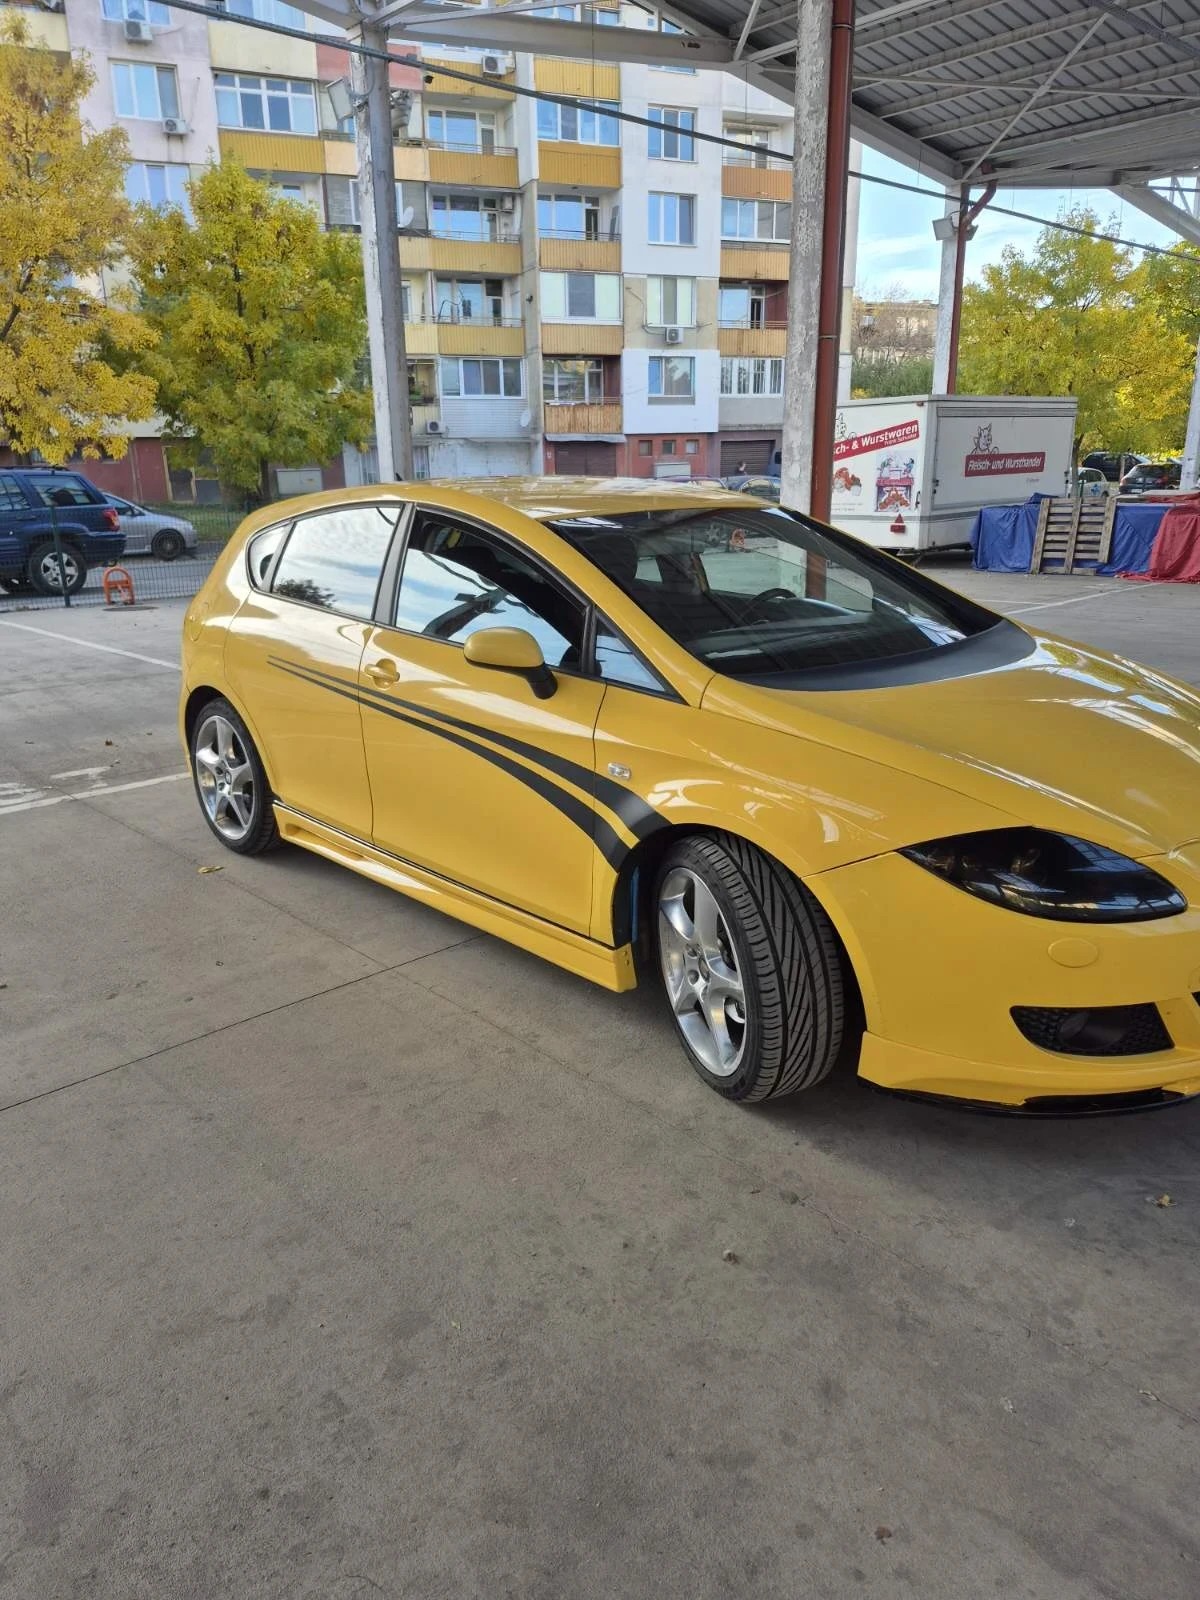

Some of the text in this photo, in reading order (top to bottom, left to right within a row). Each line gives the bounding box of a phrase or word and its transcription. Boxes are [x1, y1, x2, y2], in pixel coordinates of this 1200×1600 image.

[833, 424, 918, 455] ch- & Wurstwaren
[968, 456, 1042, 471] Fleisch- und Wursthandel
